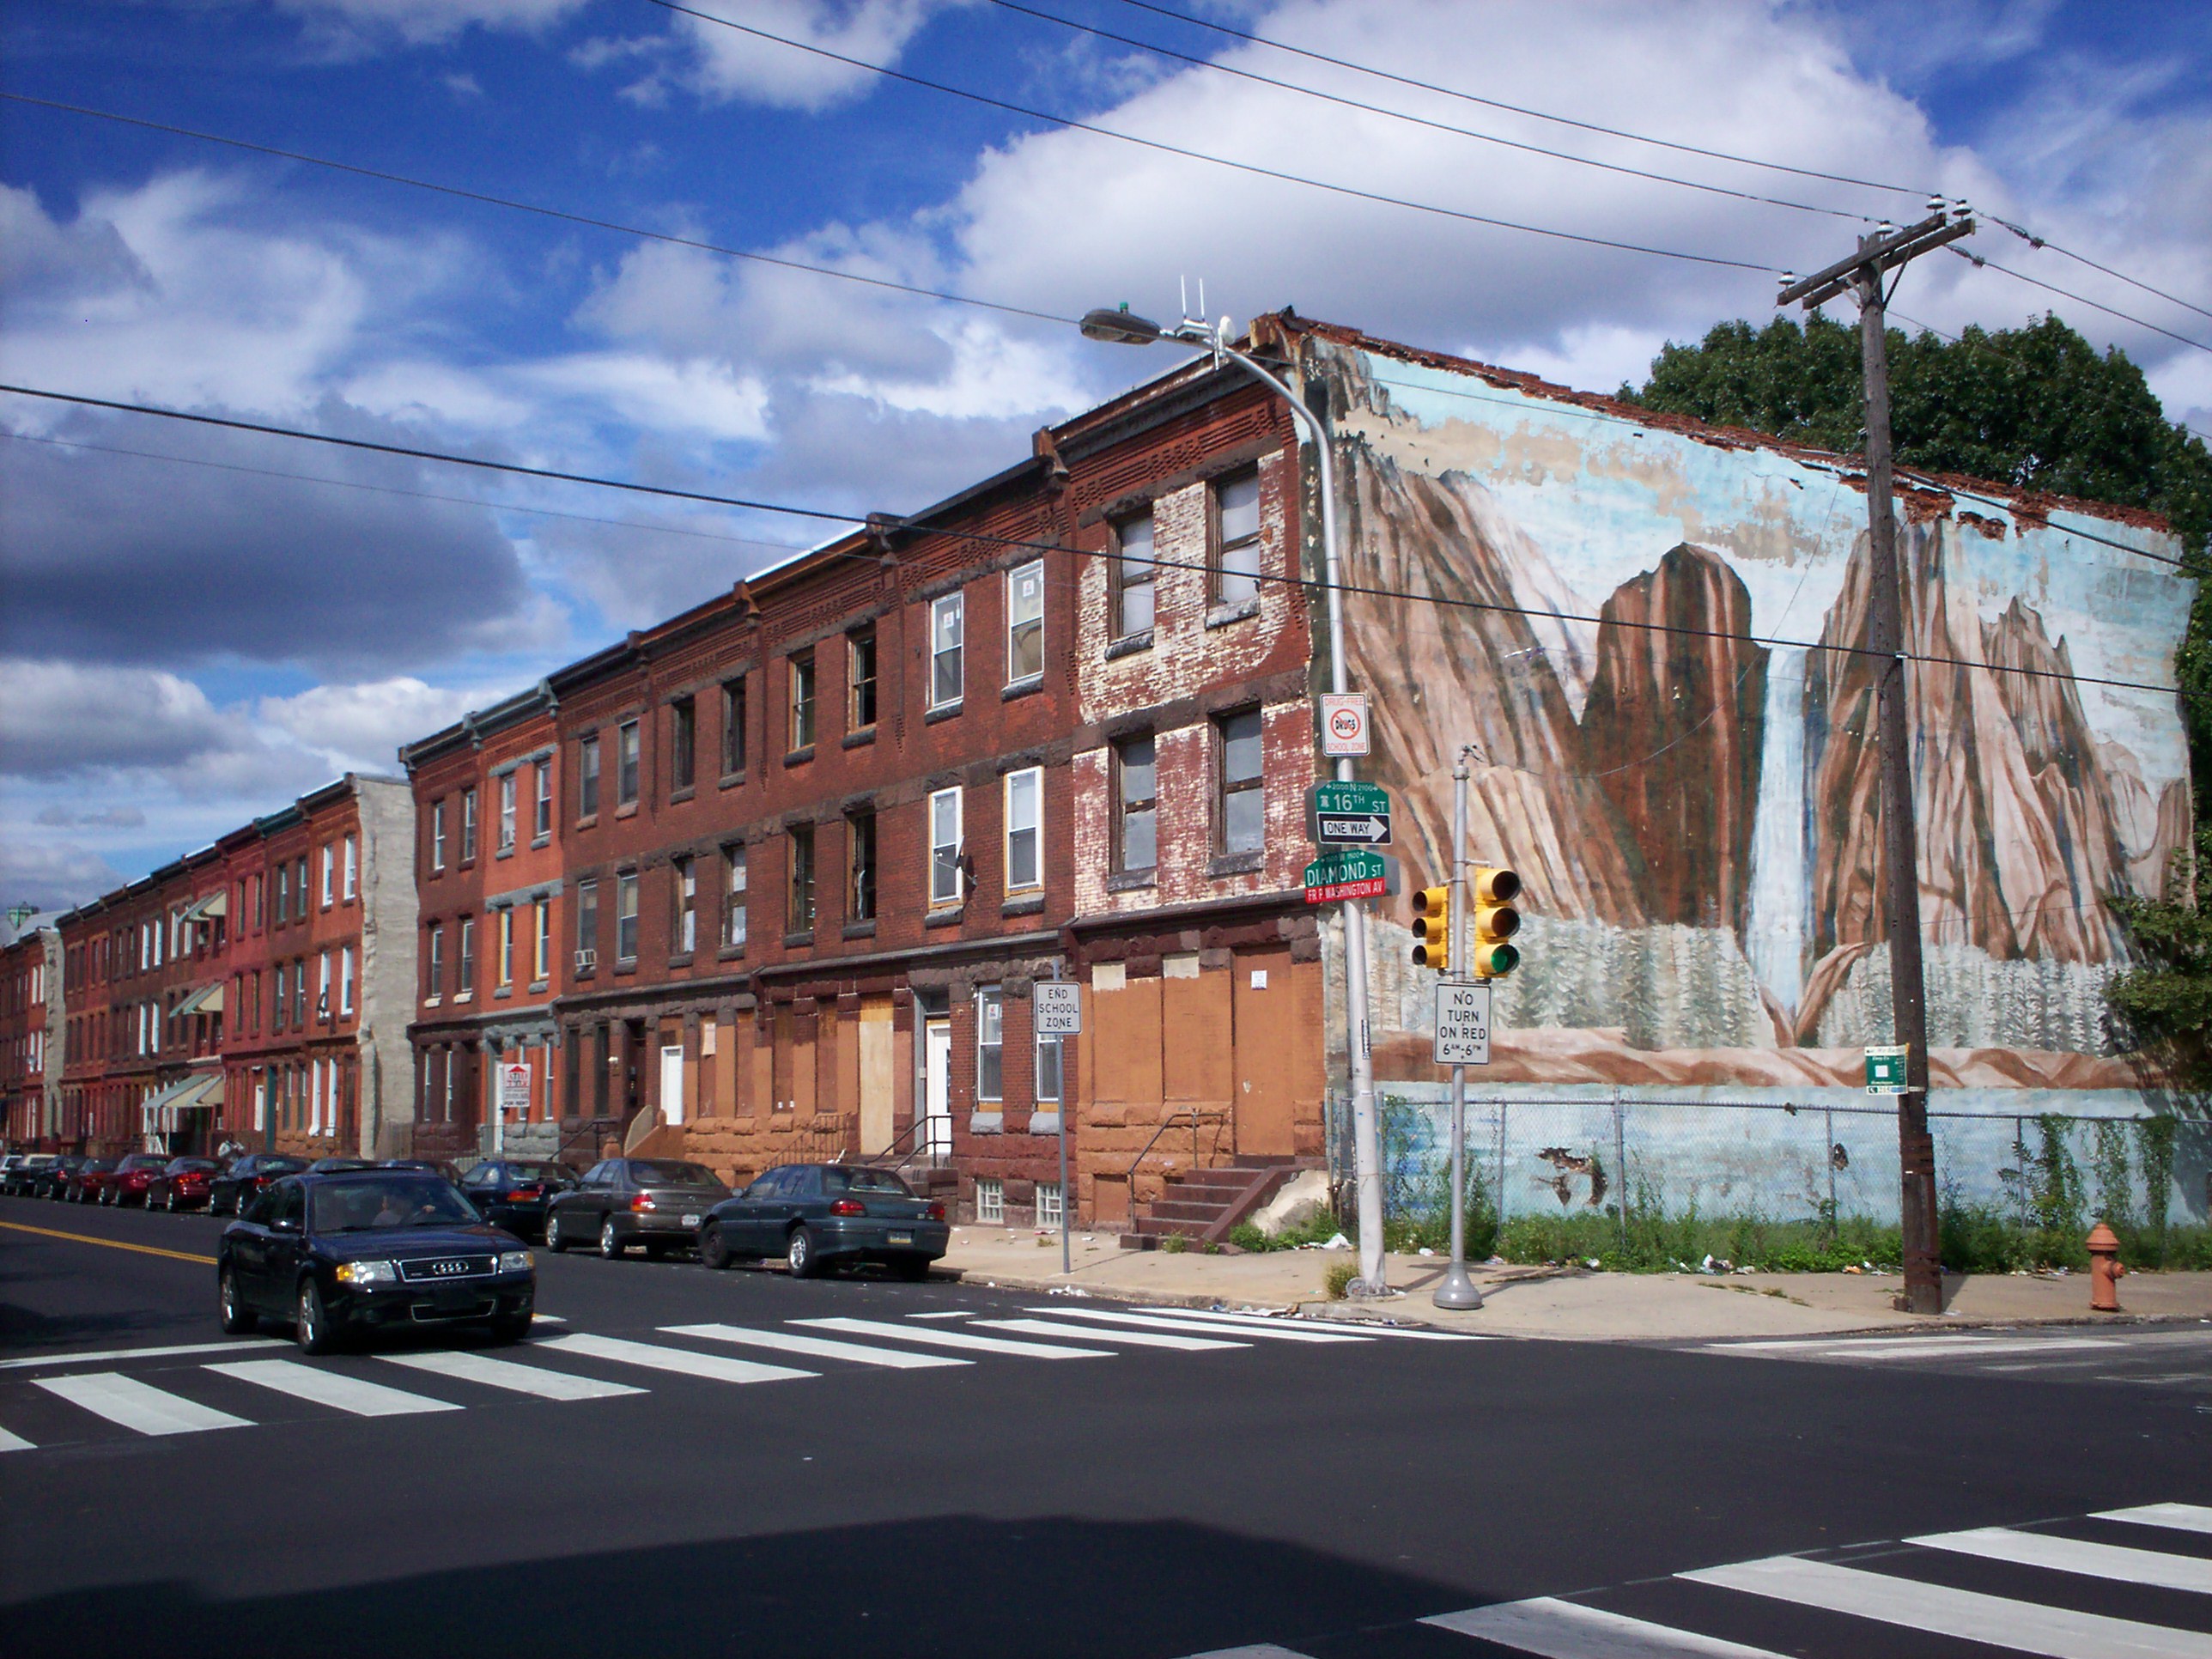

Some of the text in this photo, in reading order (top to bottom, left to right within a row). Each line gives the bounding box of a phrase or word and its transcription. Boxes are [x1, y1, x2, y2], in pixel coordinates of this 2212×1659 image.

[1335, 719, 1356, 730] DRUGS
[1327, 742, 1366, 751] SCHOOL ZONE
[1349, 783, 1357, 792] N
[1334, 793, 1386, 812] 16TH ST
[1327, 822, 1370, 835] ONE WAY
[1306, 861, 1382, 886] DIAMOND ST
[1308, 889, 1317, 902] FR
[1325, 882, 1371, 898] WASHINGTON
[1372, 880, 1383, 893] AV
[1048, 989, 1068, 1000] END
[1454, 993, 1474, 1006] NO
[1038, 1003, 1079, 1013] SCHOOL
[1046, 1017, 1073, 1028] ZONE
[1447, 1010, 1480, 1023] TURN
[1439, 1026, 1486, 1040] ON RED
